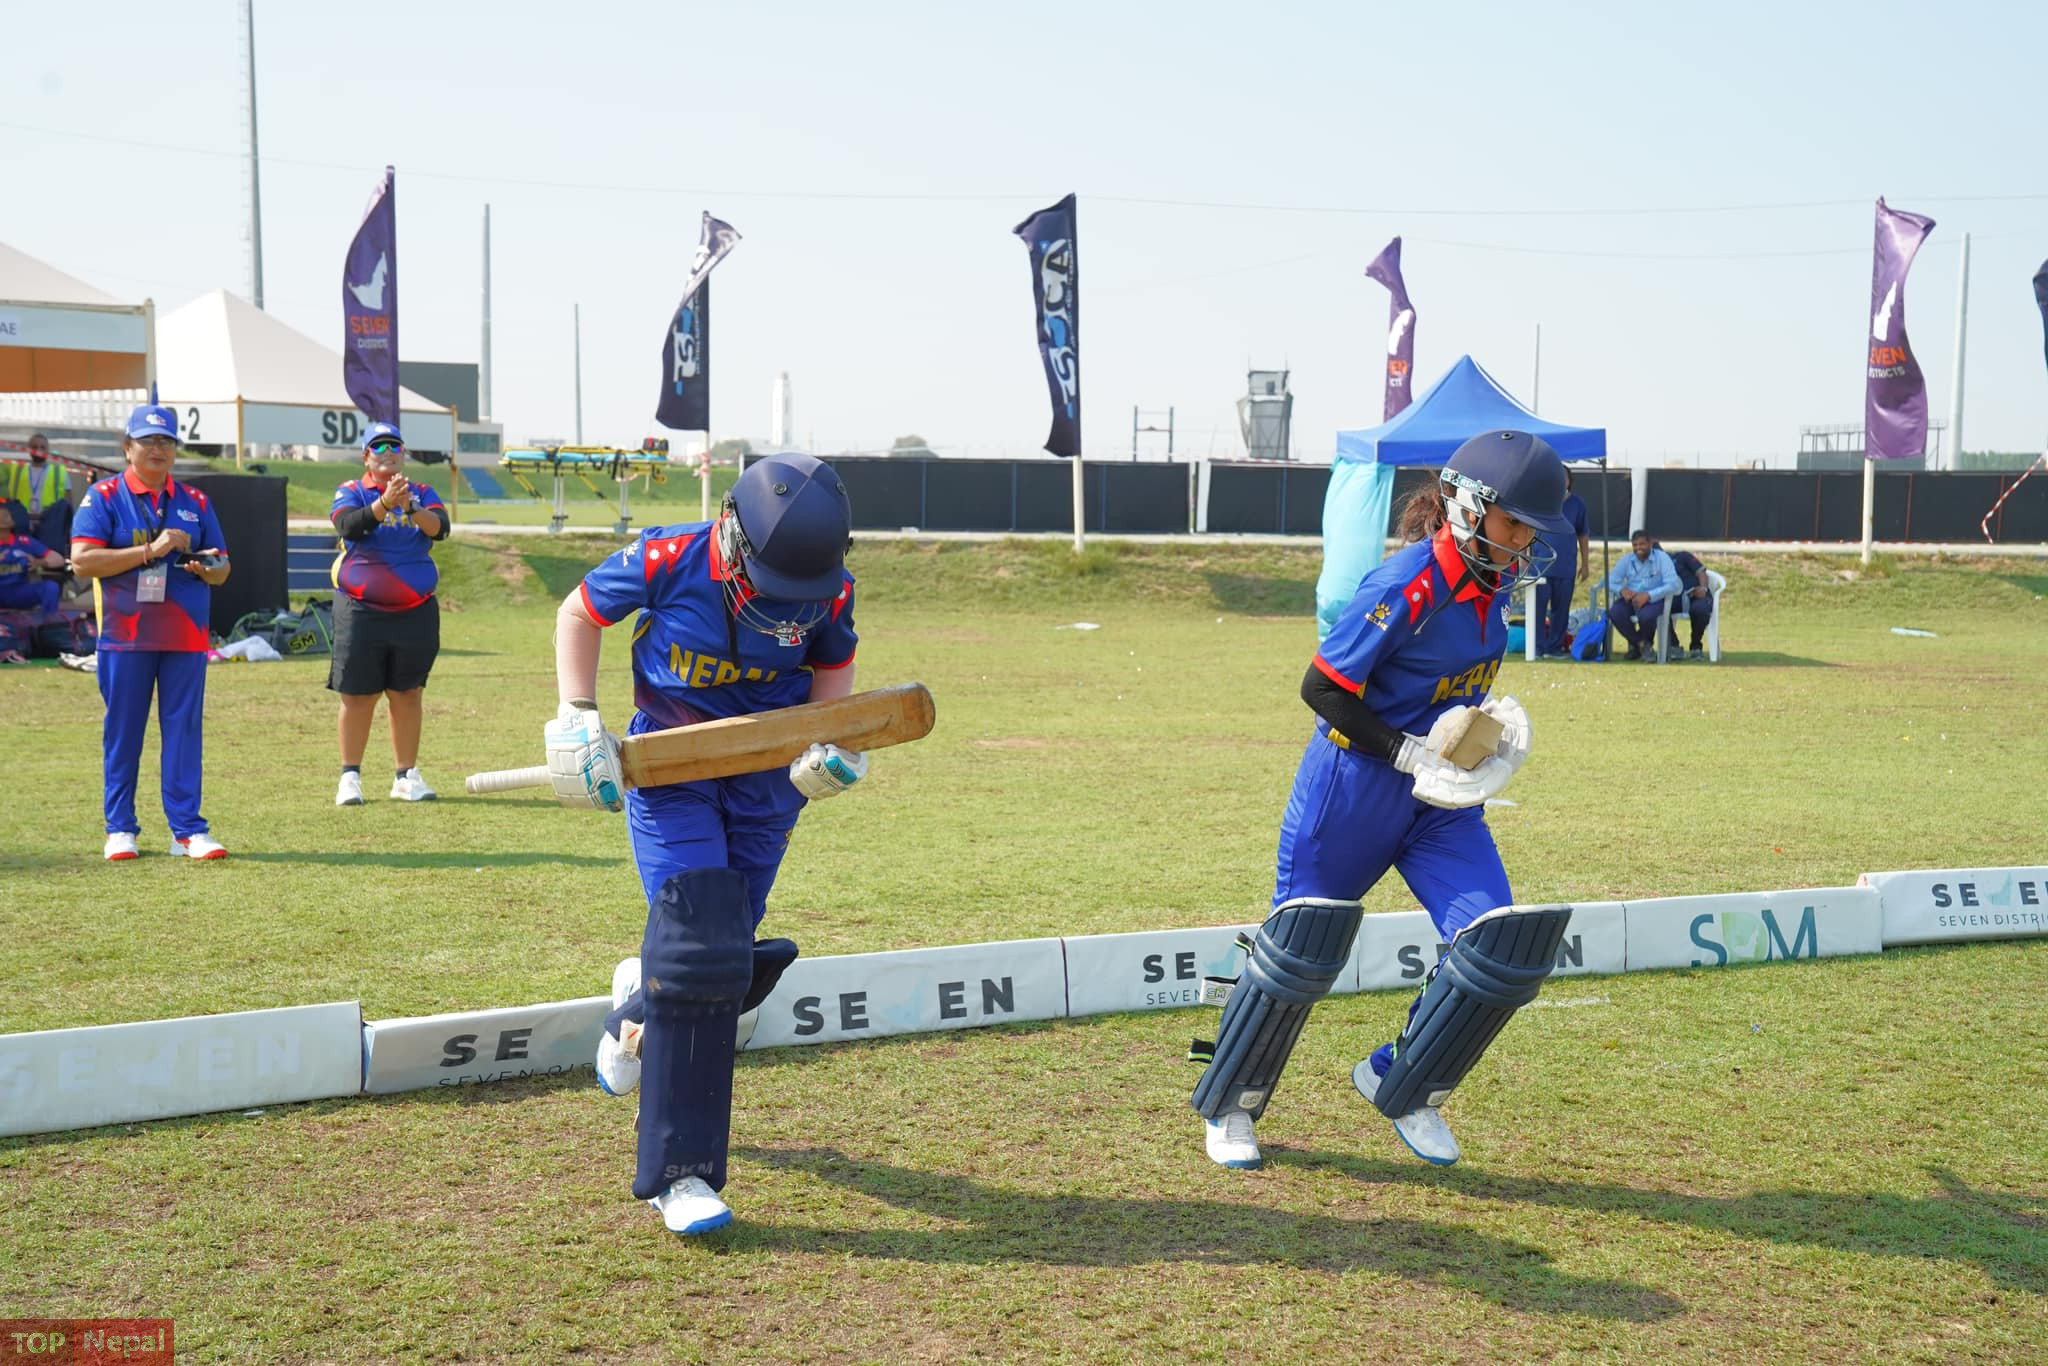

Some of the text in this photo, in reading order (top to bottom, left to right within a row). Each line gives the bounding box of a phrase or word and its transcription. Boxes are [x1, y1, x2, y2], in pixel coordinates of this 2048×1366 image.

[1430, 659, 1499, 704] NEPA
[1939, 912, 2048, 927] SEVEN DISTRI
